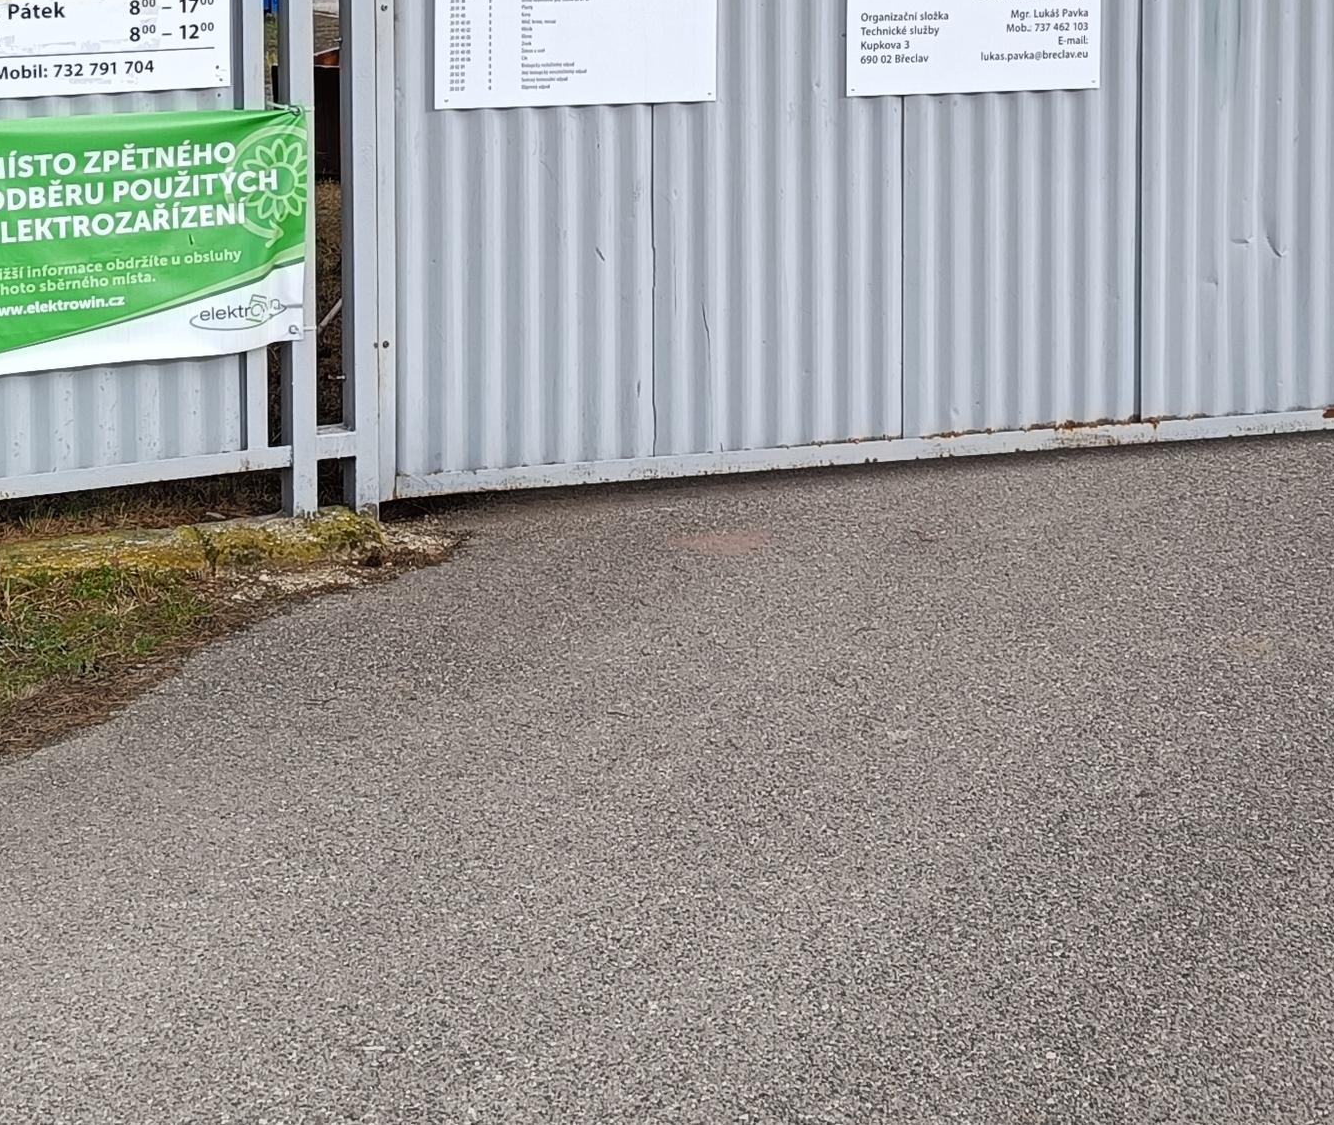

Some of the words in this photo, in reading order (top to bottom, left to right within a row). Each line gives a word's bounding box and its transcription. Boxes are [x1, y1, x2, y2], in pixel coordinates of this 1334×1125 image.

[9, 2, 65, 19] Pátek
[861, 12, 917, 24] Organizační
[920, 11, 948, 20] složka
[1034, 9, 1059, 18] Lukáš
[1062, 8, 1088, 17] Pavka
[861, 26, 906, 35] Technické
[910, 25, 939, 36] služby
[981, 50, 1088, 62] lukas.pavka@breclav.eu
[54, 64, 83, 77] 732
[90, 62, 116, 75] 791
[125, 60, 154, 74] 704
[84, 140, 235, 174] ZPĚTNÉHO
[114, 168, 278, 203] POUŽITÝCH
[27, 262, 103, 279] informace
[106, 255, 168, 272] obdržíte
[171, 256, 181, 266] u
[185, 250, 242, 265] obsluhy
[39, 277, 108, 294] sběrného
[112, 273, 156, 286] místa.
